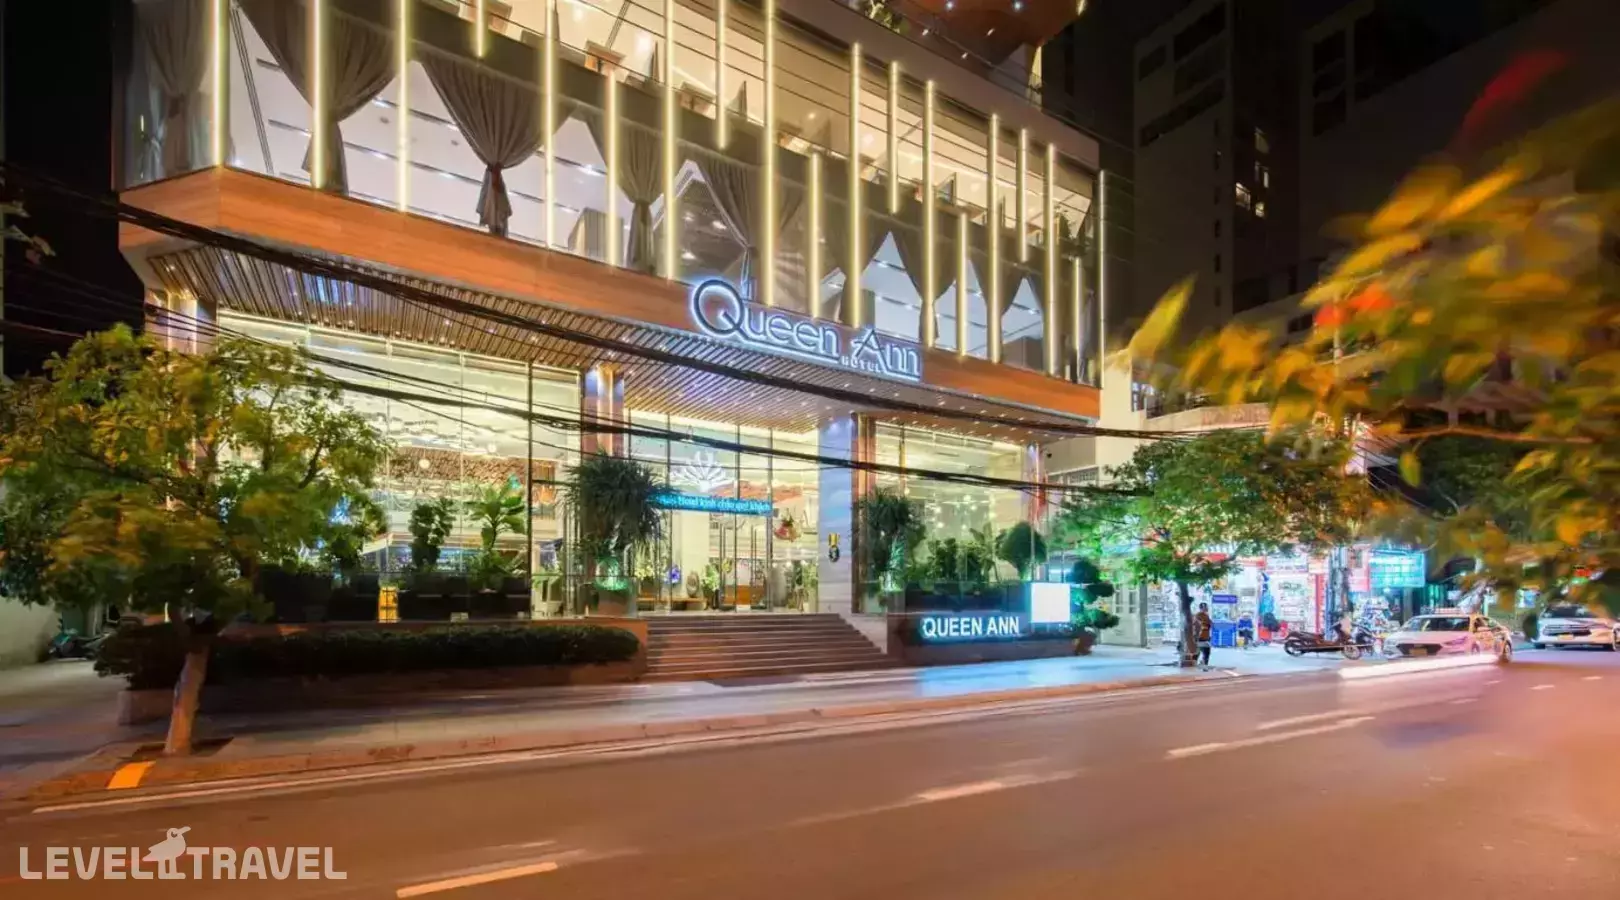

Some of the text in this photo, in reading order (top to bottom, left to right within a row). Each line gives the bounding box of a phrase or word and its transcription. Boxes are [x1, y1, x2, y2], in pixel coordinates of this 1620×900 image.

[692, 278, 921, 381] Queen Ann
[921, 616, 1020, 638] QUEEN ANN
